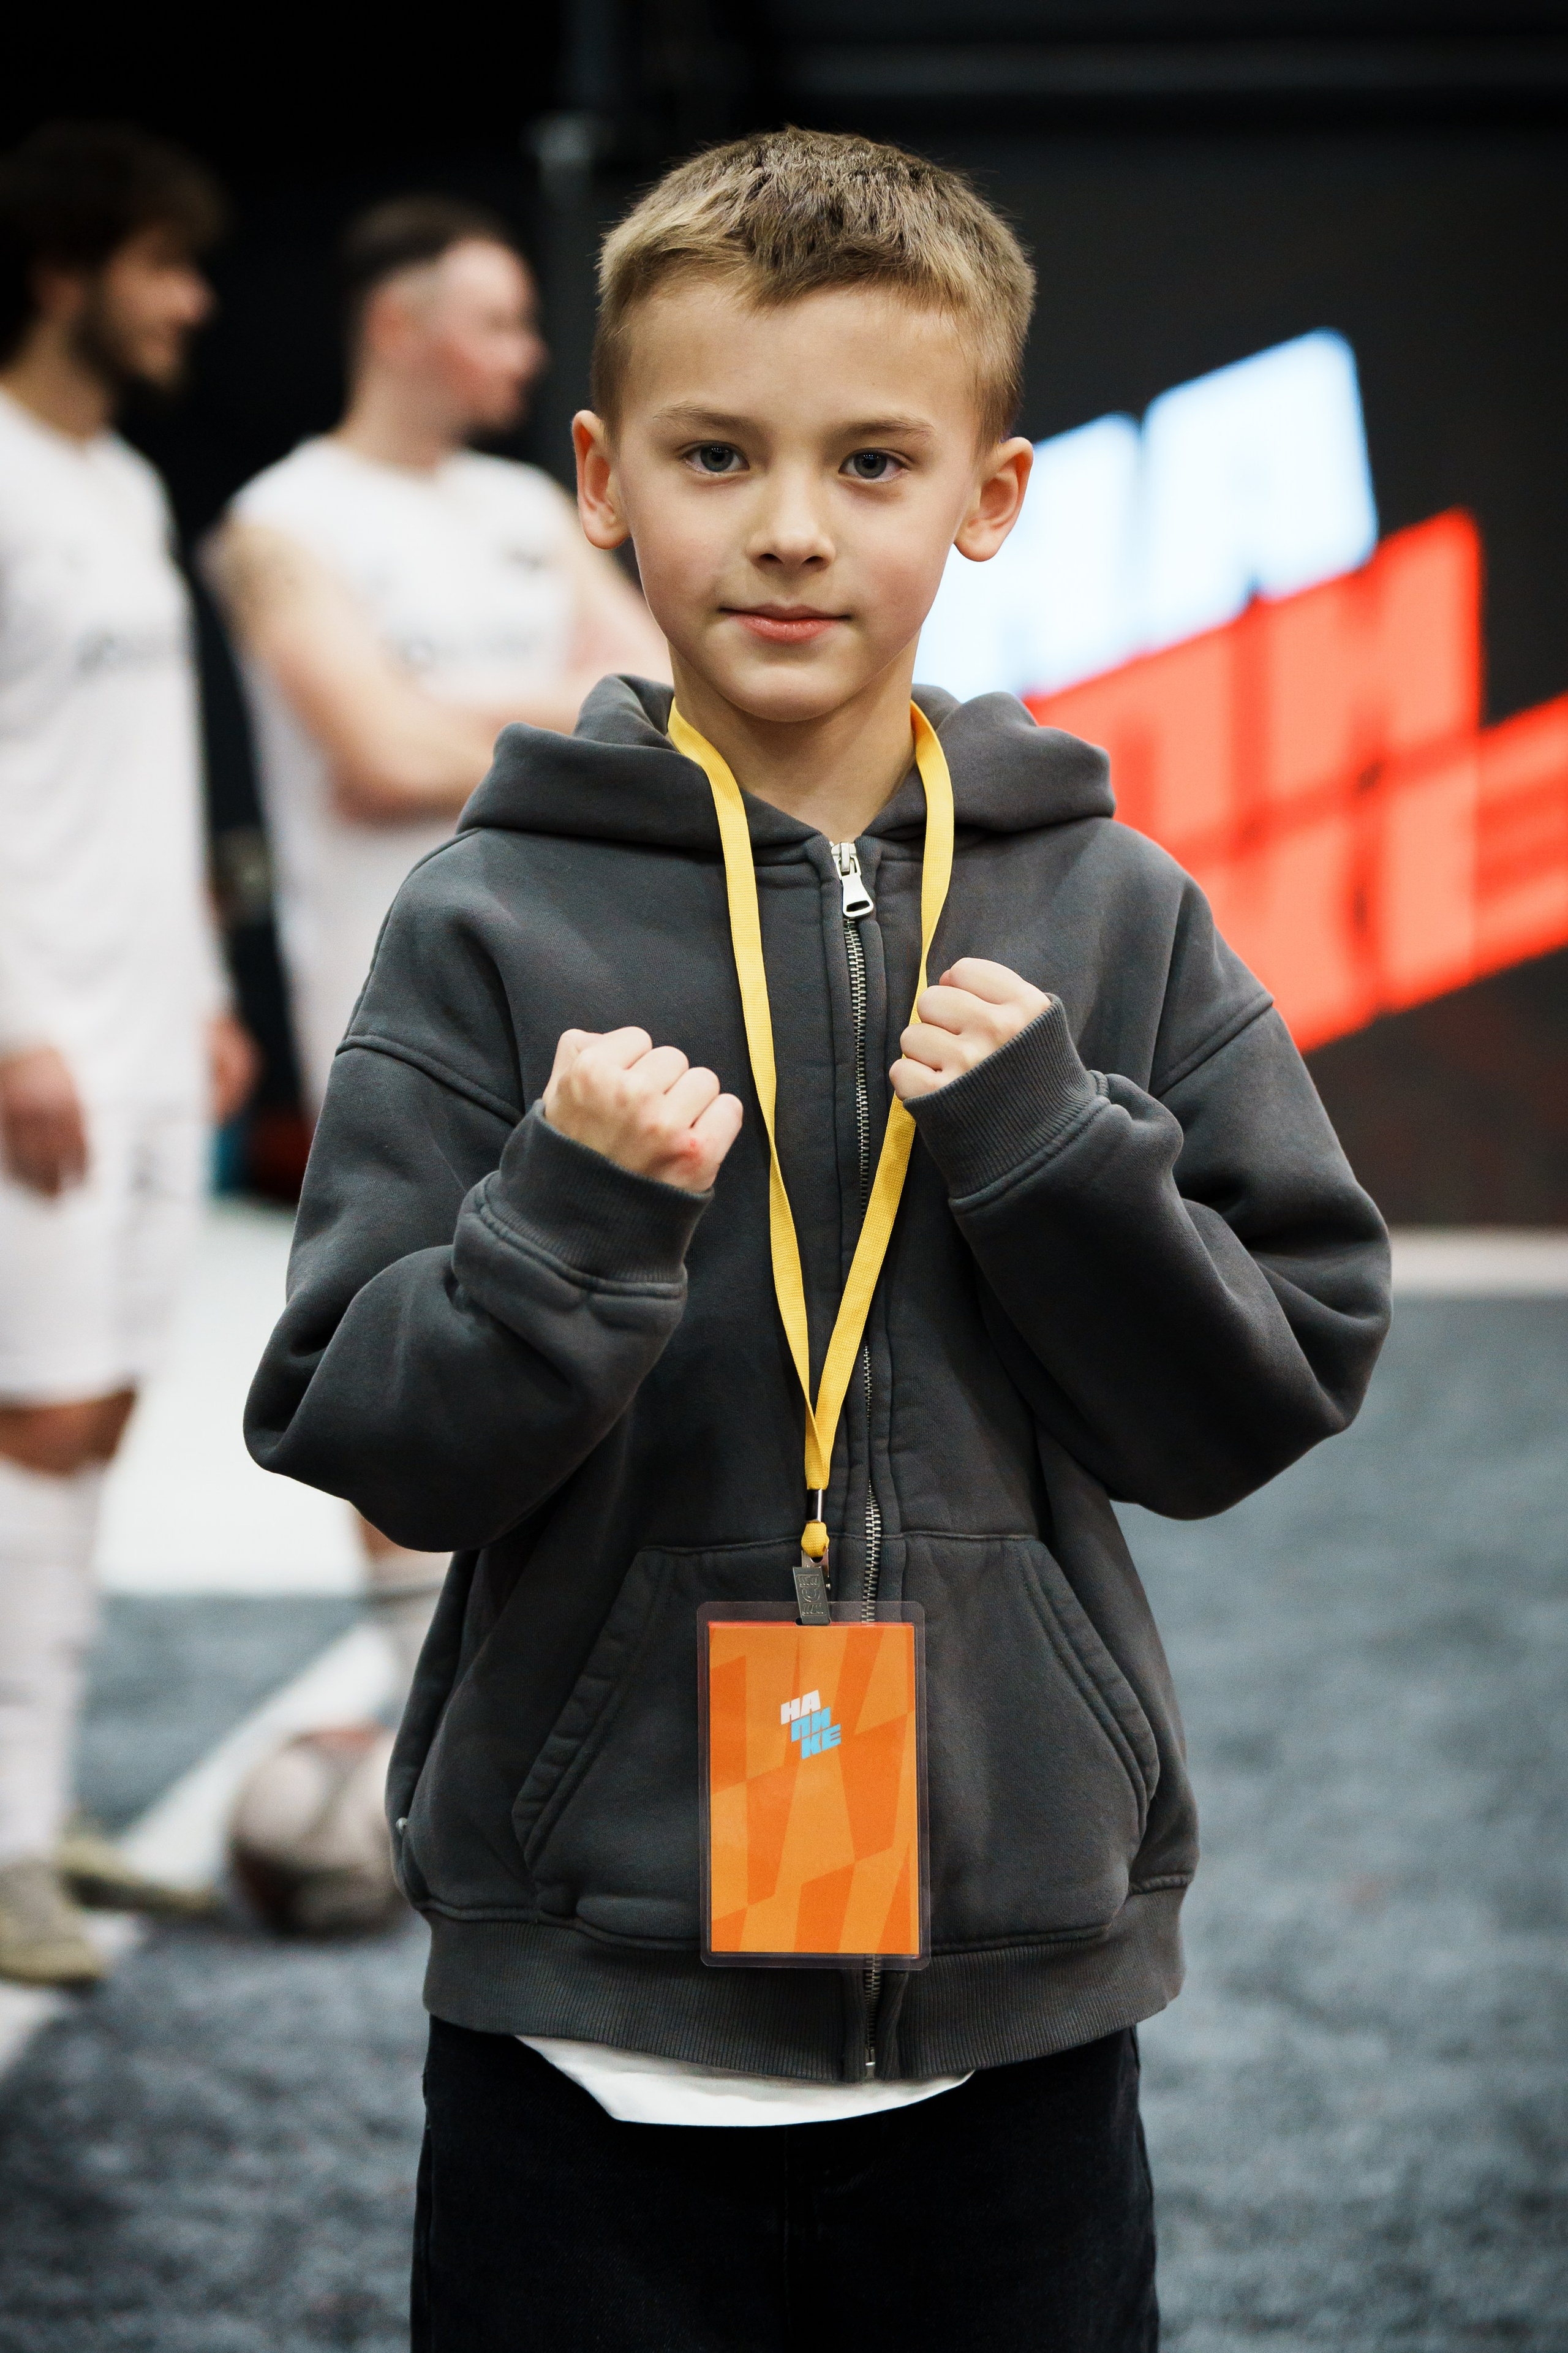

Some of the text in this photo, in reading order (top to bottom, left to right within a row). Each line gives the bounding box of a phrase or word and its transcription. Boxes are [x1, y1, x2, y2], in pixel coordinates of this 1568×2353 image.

[781, 1690, 821, 1725] НА
[791, 1706, 831, 1742] ПИ
[801, 1723, 841, 1759] КЕ
